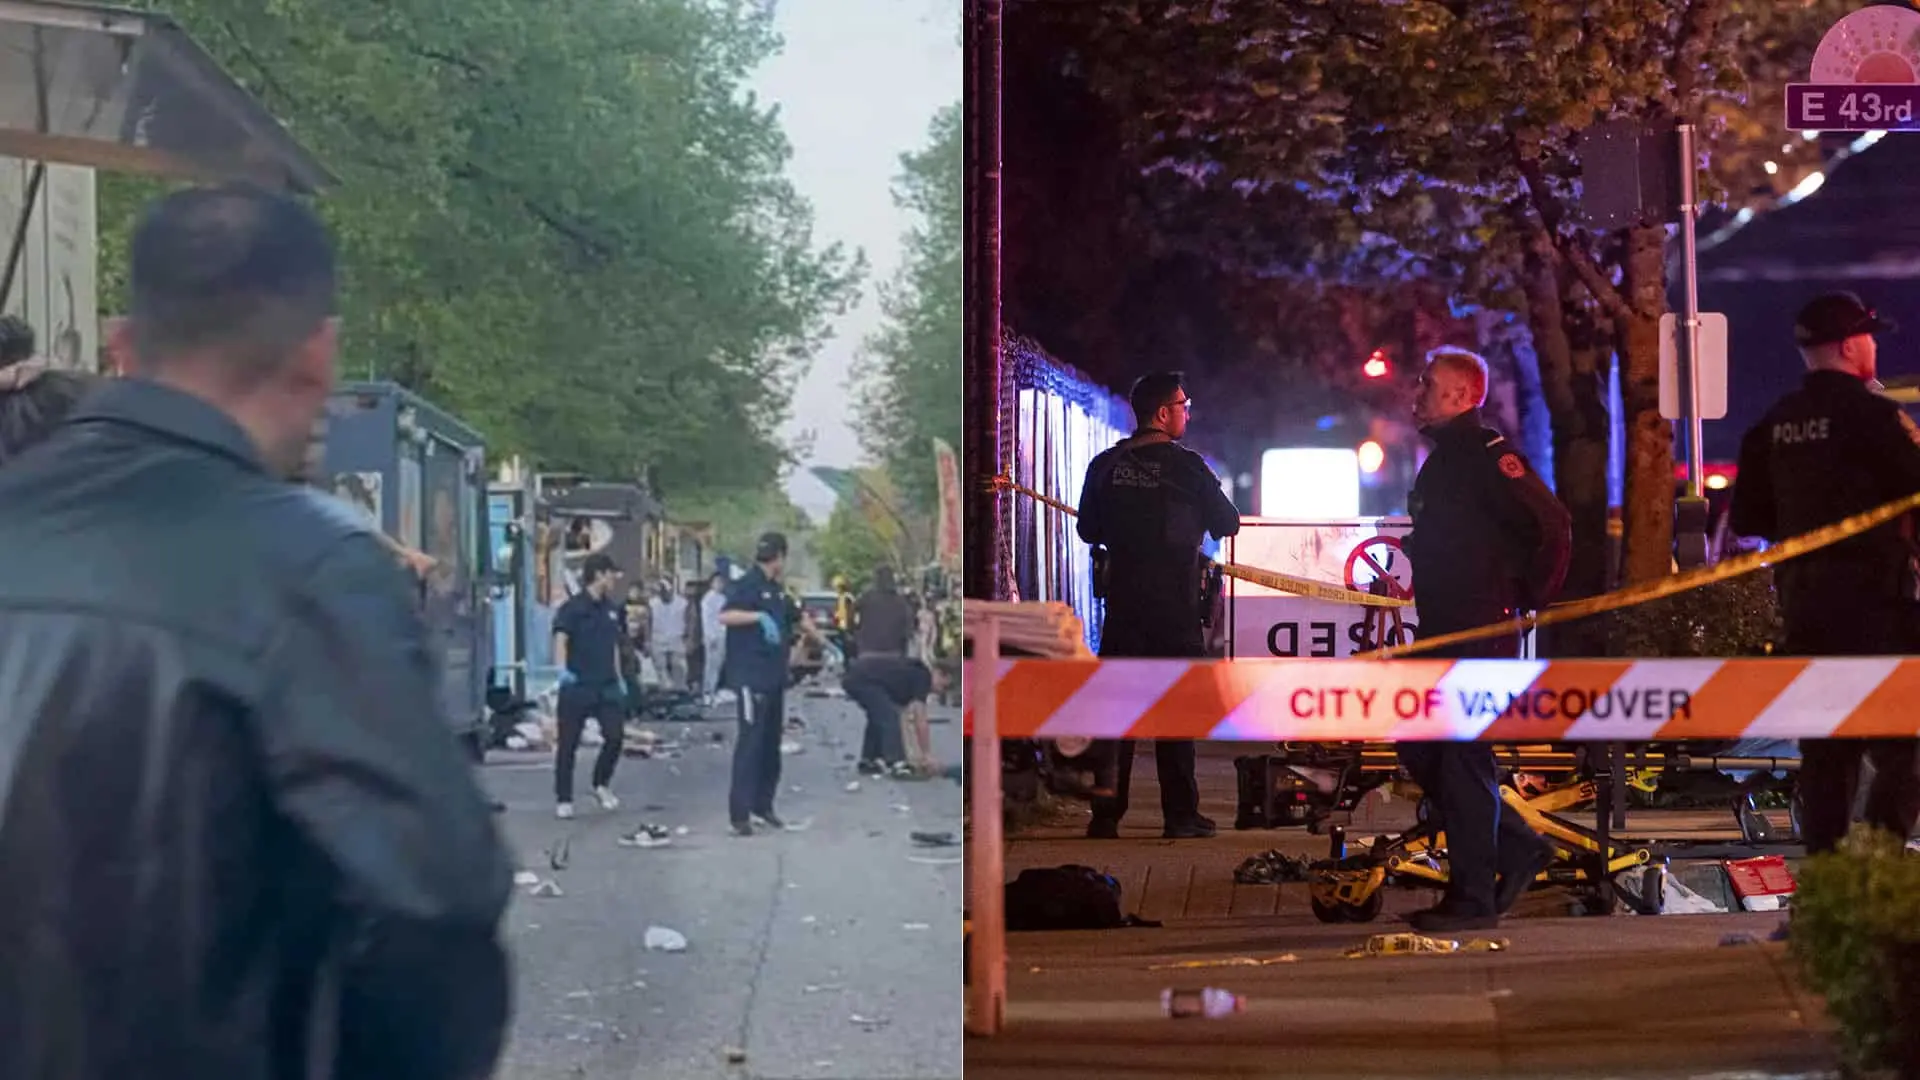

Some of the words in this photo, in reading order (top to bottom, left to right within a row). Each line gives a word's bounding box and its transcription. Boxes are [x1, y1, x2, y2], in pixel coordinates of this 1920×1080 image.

[1802, 92, 1825, 121] E
[1838, 92, 1911, 122] 43rd
[1772, 417, 1830, 444] POLICE
[1290, 688, 1377, 719] CITY
[1394, 688, 1442, 719] OF
[1457, 688, 1692, 719] VANCOUVER
